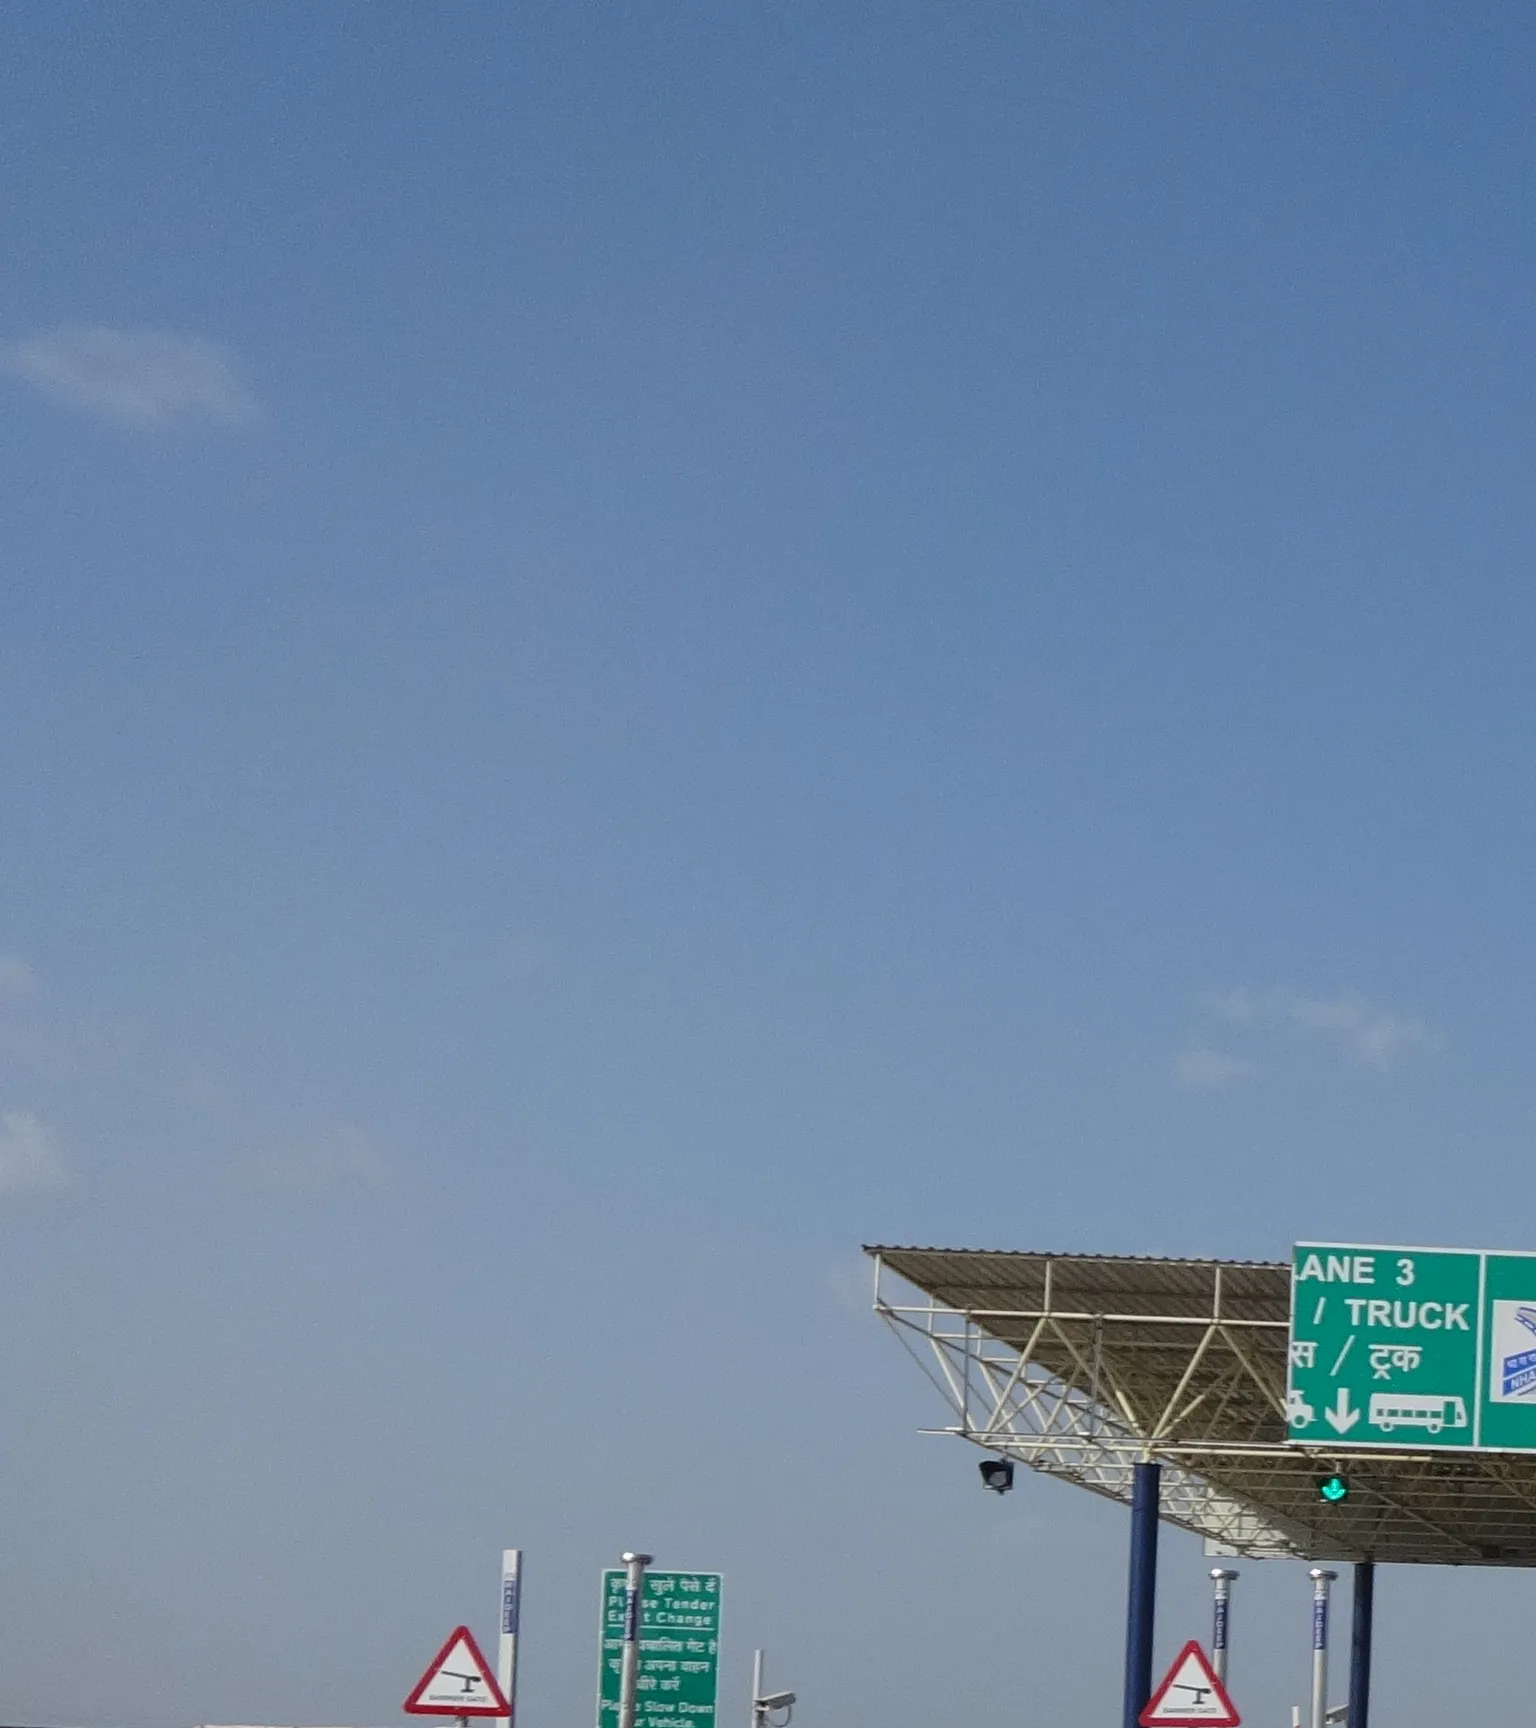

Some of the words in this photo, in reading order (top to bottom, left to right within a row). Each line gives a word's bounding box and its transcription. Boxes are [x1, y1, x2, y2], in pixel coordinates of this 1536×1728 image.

[1395, 1258, 1415, 1286] 3
[1344, 1298, 1470, 1331] TRUCK
[1368, 1344, 1423, 1380] ट्रक
[608, 1596, 658, 1608] Plse
[664, 1598, 715, 1610] Tender
[656, 1612, 712, 1626] Change
[678, 1702, 713, 1714] Down
